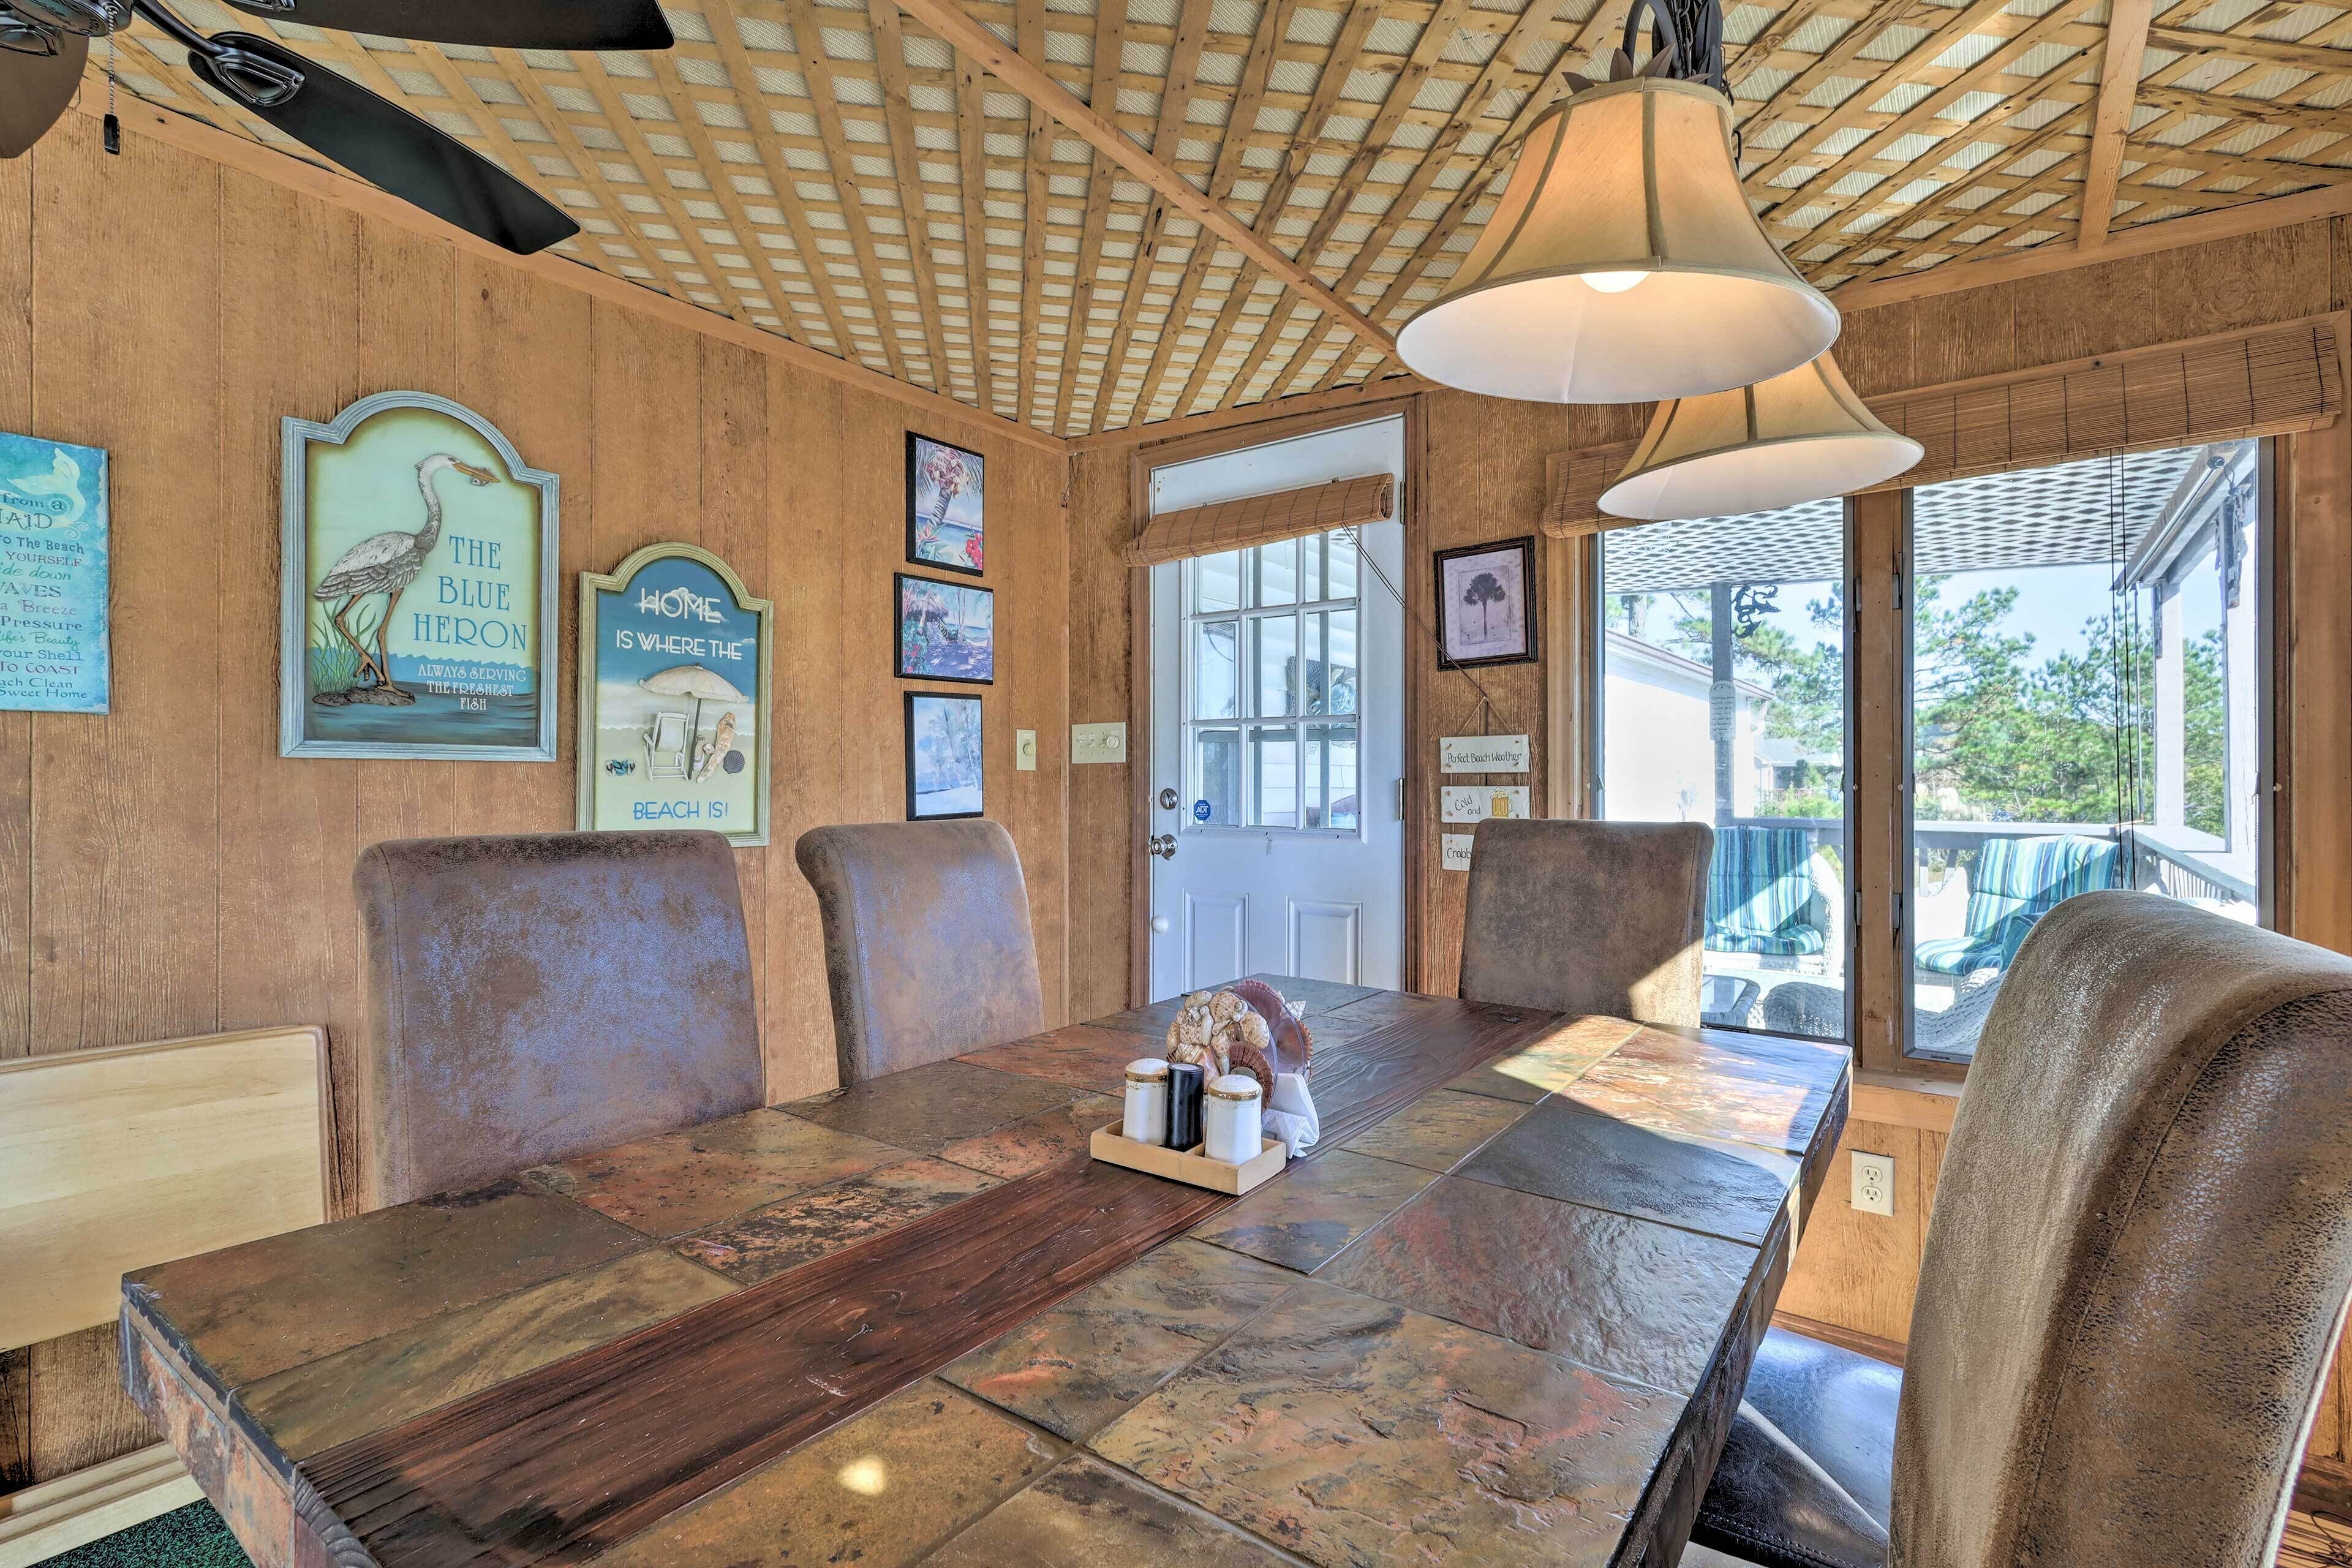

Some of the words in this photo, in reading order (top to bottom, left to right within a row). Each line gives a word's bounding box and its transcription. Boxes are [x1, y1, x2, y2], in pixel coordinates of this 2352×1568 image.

[3, 492, 43, 508] from
[51, 501, 64, 510] a
[17, 537, 40, 549] The
[46, 540, 85, 554] Beach
[449, 534, 501, 570] THE
[6, 551, 82, 567] YOURSELF
[29, 565, 71, 580] down
[437, 575, 510, 611] BLUE
[18, 599, 77, 616] Breeze
[641, 587, 720, 624] HOME
[1, 616, 84, 631] Pressure
[413, 612, 527, 651] HERON
[0, 630, 26, 643] ife's
[29, 631, 80, 651] Beauty
[616, 630, 633, 649] IS
[636, 632, 705, 657] WHERE
[709, 639, 742, 660] THE
[38, 650, 85, 661] Shell
[26, 663, 81, 674] COAST
[418, 663, 467, 679] ALWAYS
[469, 666, 527, 682] SERVING
[0, 677, 23, 687] ach
[29, 678, 73, 688] Clean
[426, 680, 450, 694] THE
[452, 683, 514, 696] FRESHEST
[0, 687, 42, 697] Sweet
[47, 688, 88, 698] Home
[460, 697, 487, 710] FISH
[1448, 753, 1470, 764] Perfect
[1471, 753, 1490, 763] Beach
[1491, 752, 1522, 761] Weather
[633, 801, 699, 820] BEACH
[708, 801, 728, 818] IS!
[1455, 794, 1473, 811] Cold
[1468, 805, 1480, 815] and
[1447, 848, 1472, 859] Crabb
